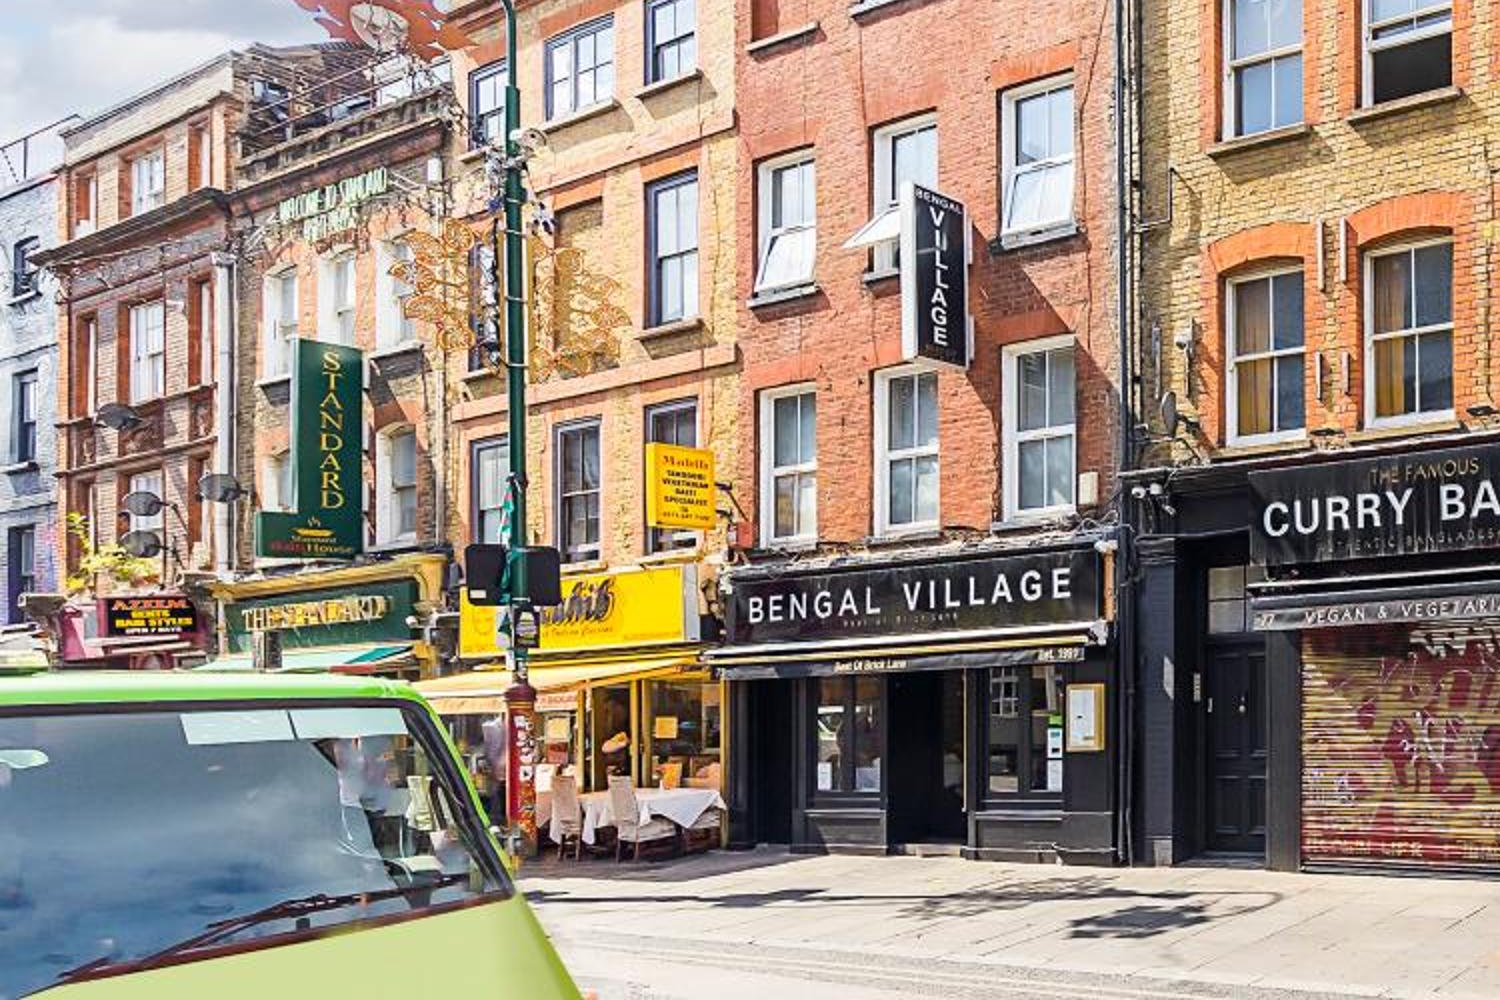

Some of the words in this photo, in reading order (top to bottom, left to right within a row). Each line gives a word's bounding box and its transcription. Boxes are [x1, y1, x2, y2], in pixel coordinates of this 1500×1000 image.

[916, 188, 963, 215] BENGAL
[930, 206, 949, 347] VILLAGE
[319, 351, 344, 509] STANDARD
[1369, 467, 1400, 484] THE
[1404, 457, 1480, 481] FAMOUS
[1263, 488, 1413, 537] CURRY
[242, 606, 277, 632] THE
[280, 595, 388, 628] STANDARD
[749, 586, 880, 623] BENGAL
[903, 567, 1072, 611] VILLAGE
[1305, 606, 1365, 624] VEGAN
[1377, 605, 1388, 619] &
